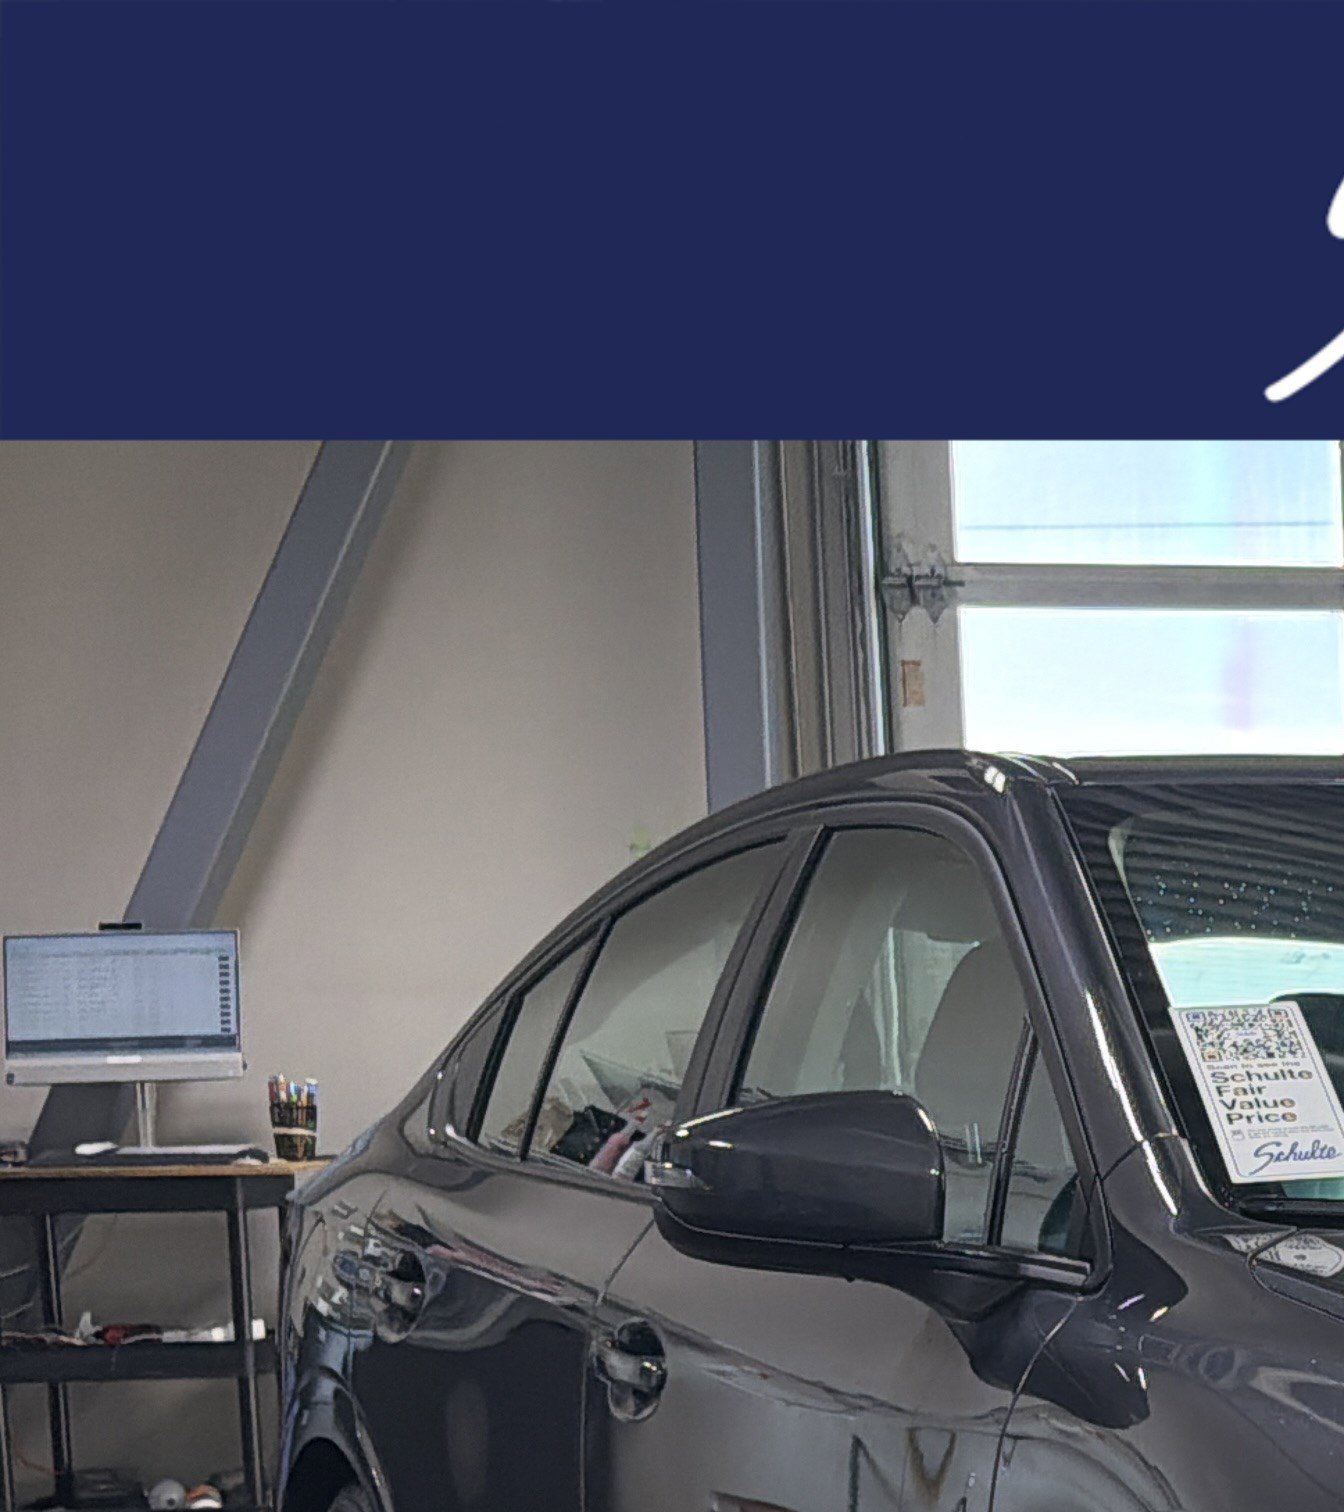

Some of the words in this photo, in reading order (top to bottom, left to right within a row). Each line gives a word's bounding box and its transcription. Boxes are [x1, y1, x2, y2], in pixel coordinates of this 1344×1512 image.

[1210, 1069, 1313, 1083] Schulte
[1215, 1083, 1267, 1097] Fair
[1219, 1097, 1297, 1110] Value
[1226, 1111, 1298, 1125] Price
[1249, 1139, 1343, 1176] Schulte
